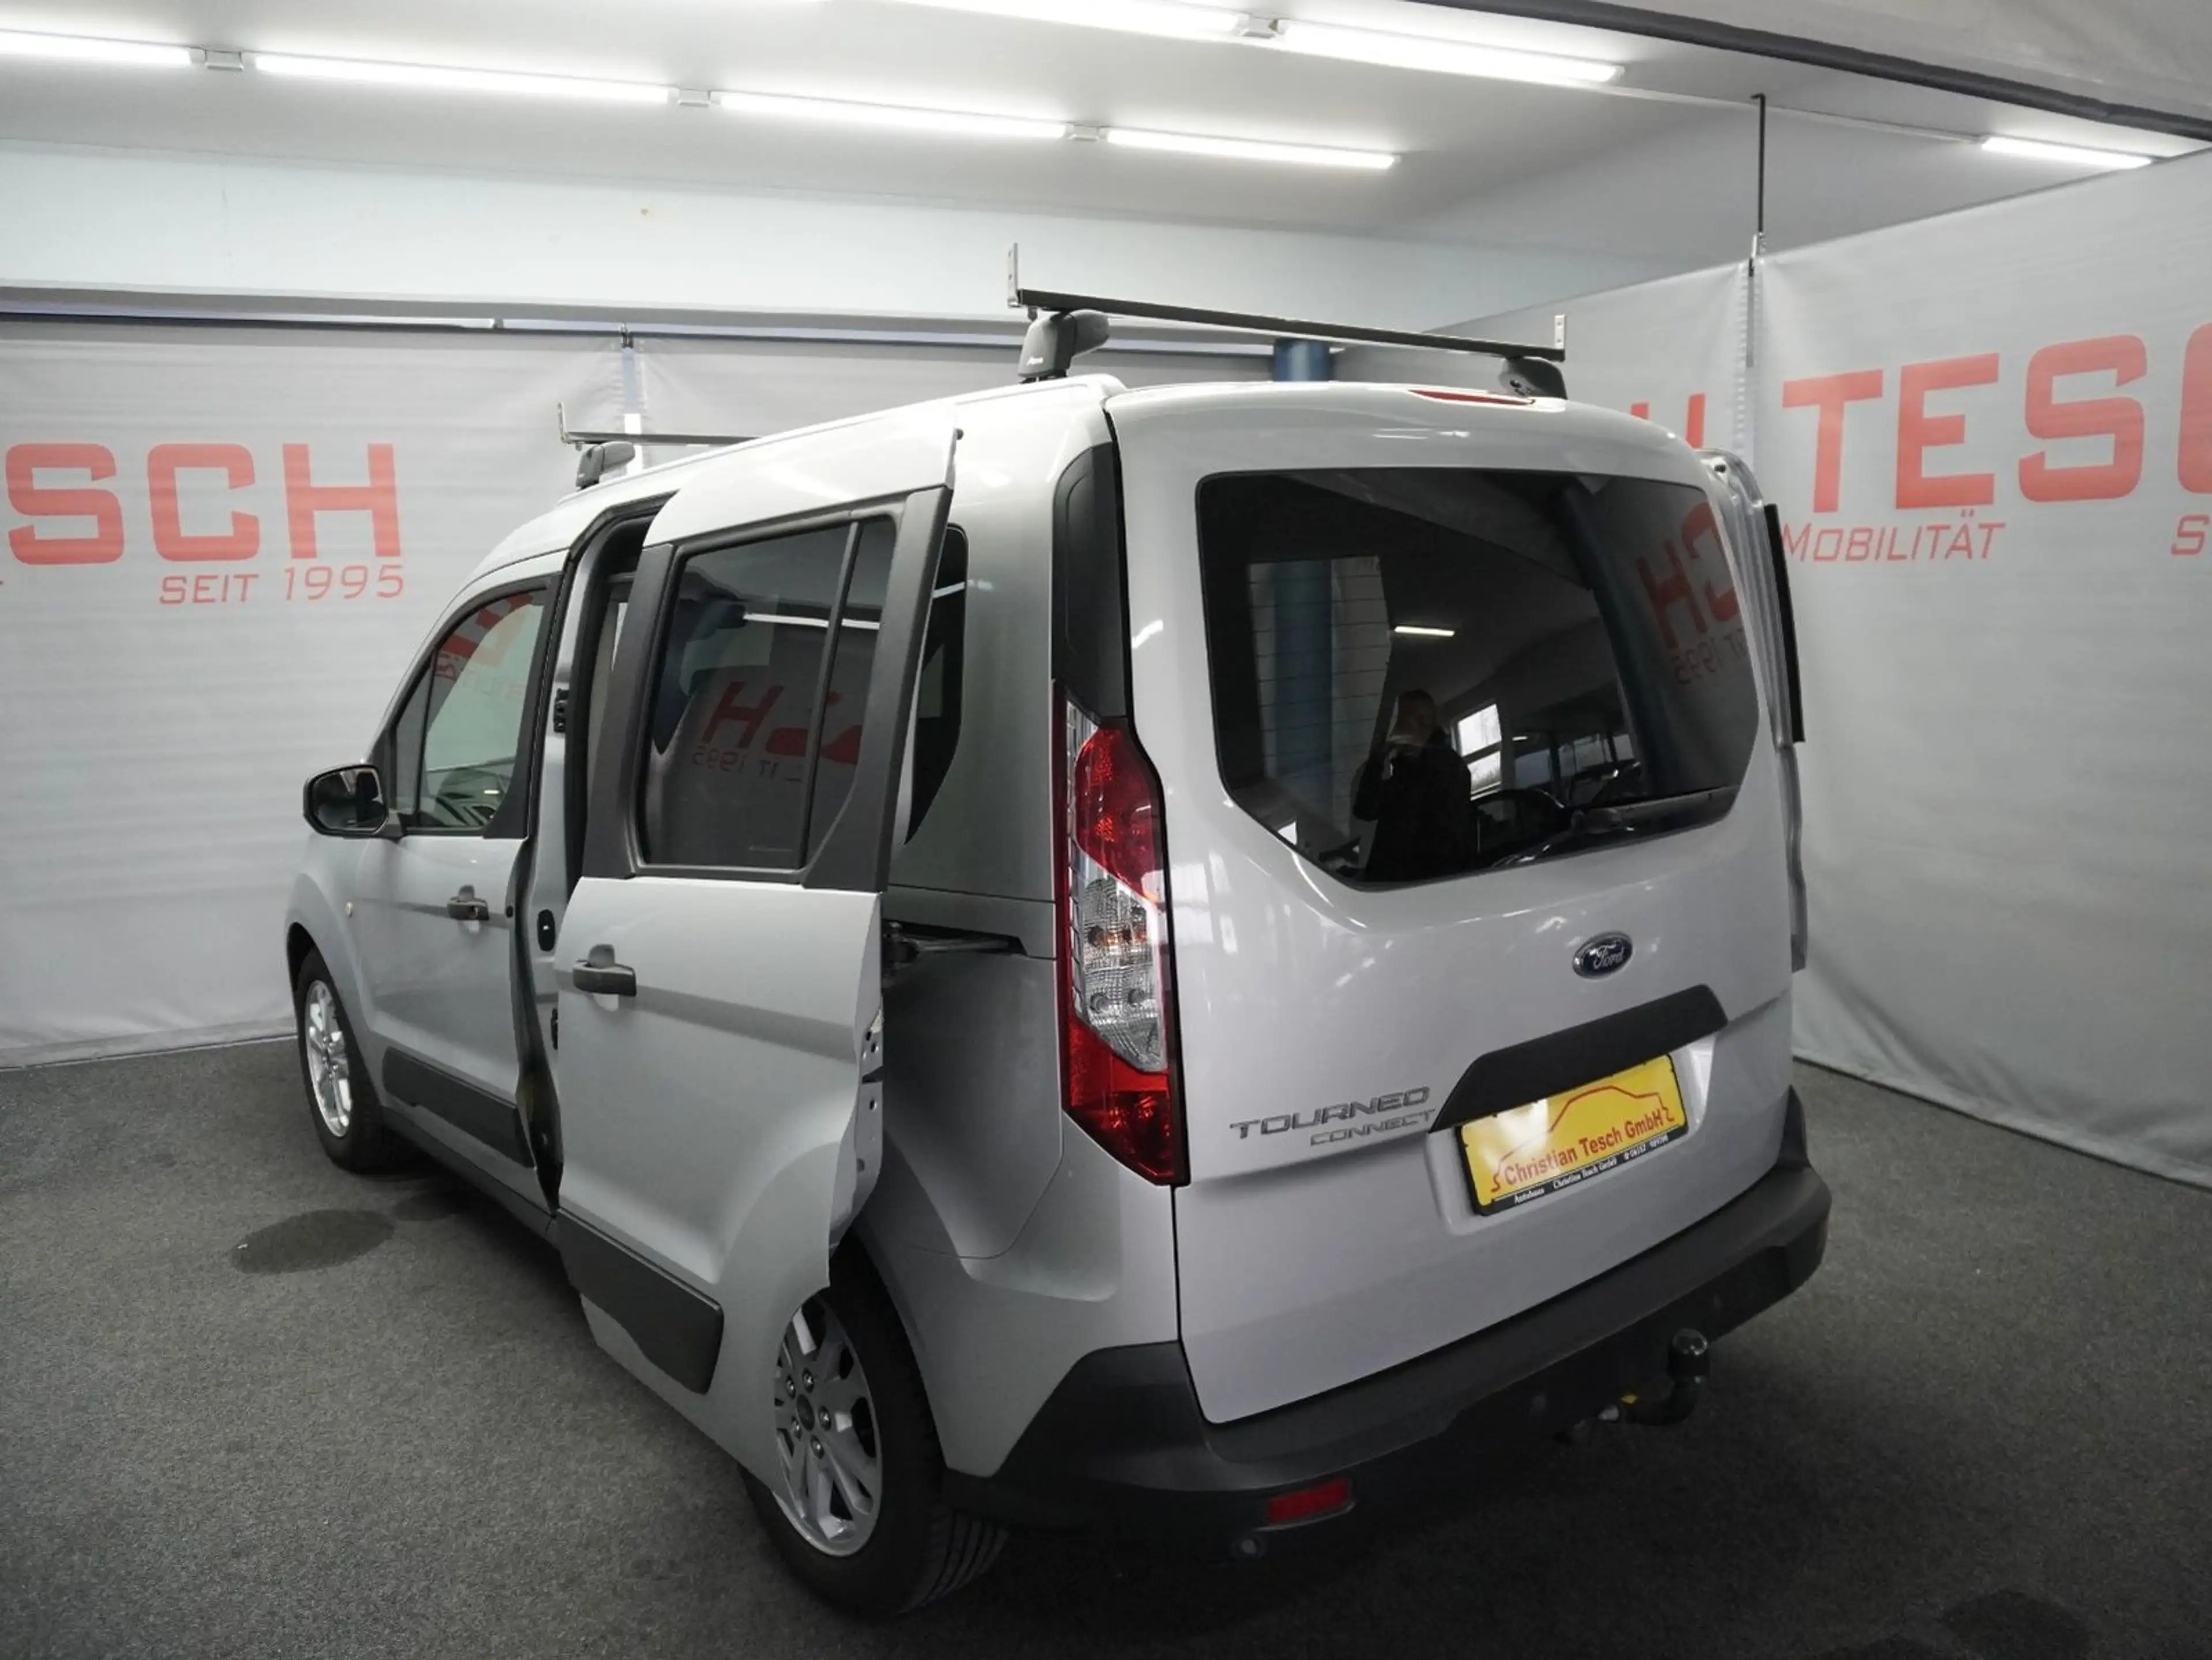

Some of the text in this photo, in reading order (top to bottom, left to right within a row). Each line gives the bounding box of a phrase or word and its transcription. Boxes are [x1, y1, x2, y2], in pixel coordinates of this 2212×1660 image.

[1783, 320, 2212, 513] TES
[5, 443, 402, 565] SCH
[1782, 508, 2005, 562] MOBILITÄT
[159, 565, 404, 605] SEIT 1995
[1589, 938, 1626, 969] Ford
[1229, 1085, 1431, 1140] TOURNEO
[1309, 1106, 1436, 1146] CONNECT
[1503, 1147, 1578, 1186] Christian
[1578, 1127, 1623, 1156] Tesch
[1624, 1109, 1664, 1138] GmbH
